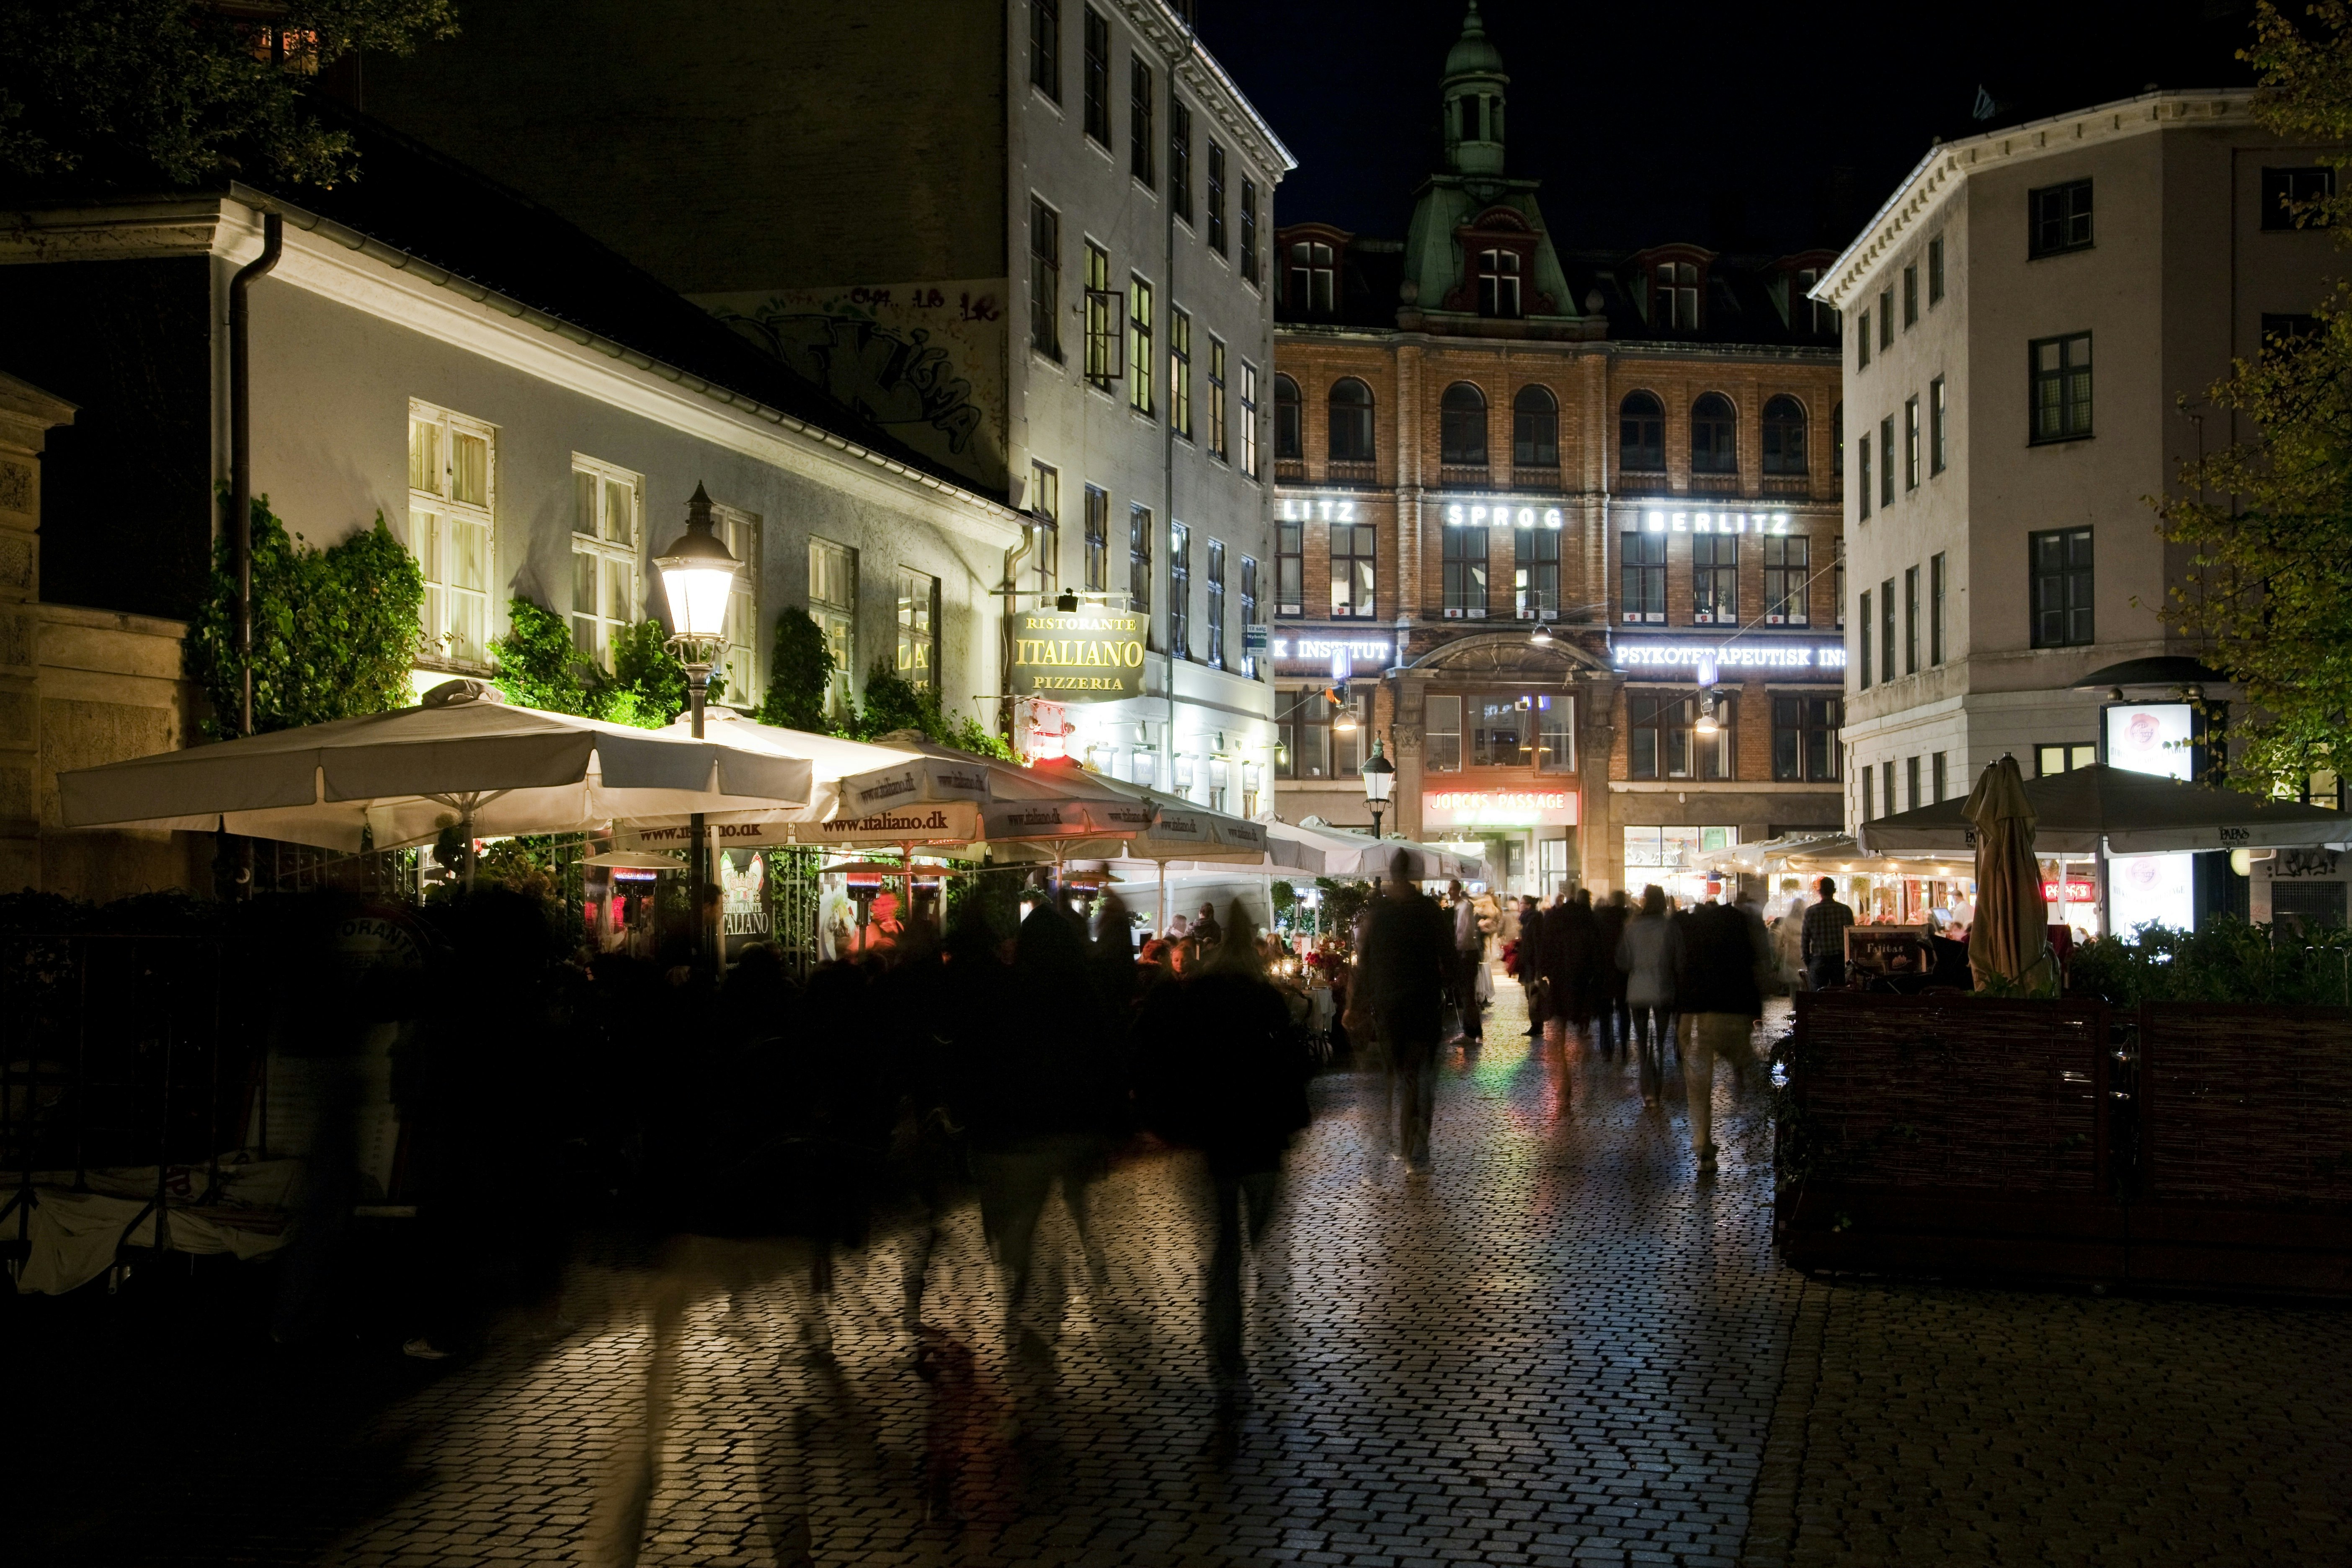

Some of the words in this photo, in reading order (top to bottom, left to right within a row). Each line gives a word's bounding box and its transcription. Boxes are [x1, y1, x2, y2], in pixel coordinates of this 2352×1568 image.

[1284, 500, 1353, 521] LITZ
[1449, 505, 1561, 527] SPROG
[1648, 511, 1787, 534] BERLITZ
[1026, 617, 1137, 631] RISTORANTE
[1015, 639, 1144, 668] ITALIANO
[1298, 641, 1388, 659] INSTTUT
[1033, 677, 1124, 691] PIZZERIA
[861, 772, 916, 805] www.italiano.dk
[1431, 793, 1489, 809] JORCKS
[1498, 794, 1565, 809] PASSAGE
[822, 811, 948, 832] www.italiano.dk
[723, 903, 762, 913] RISTORANTE
[717, 913, 769, 935] TALIANO
[1867, 943, 1903, 955] Fajitas
